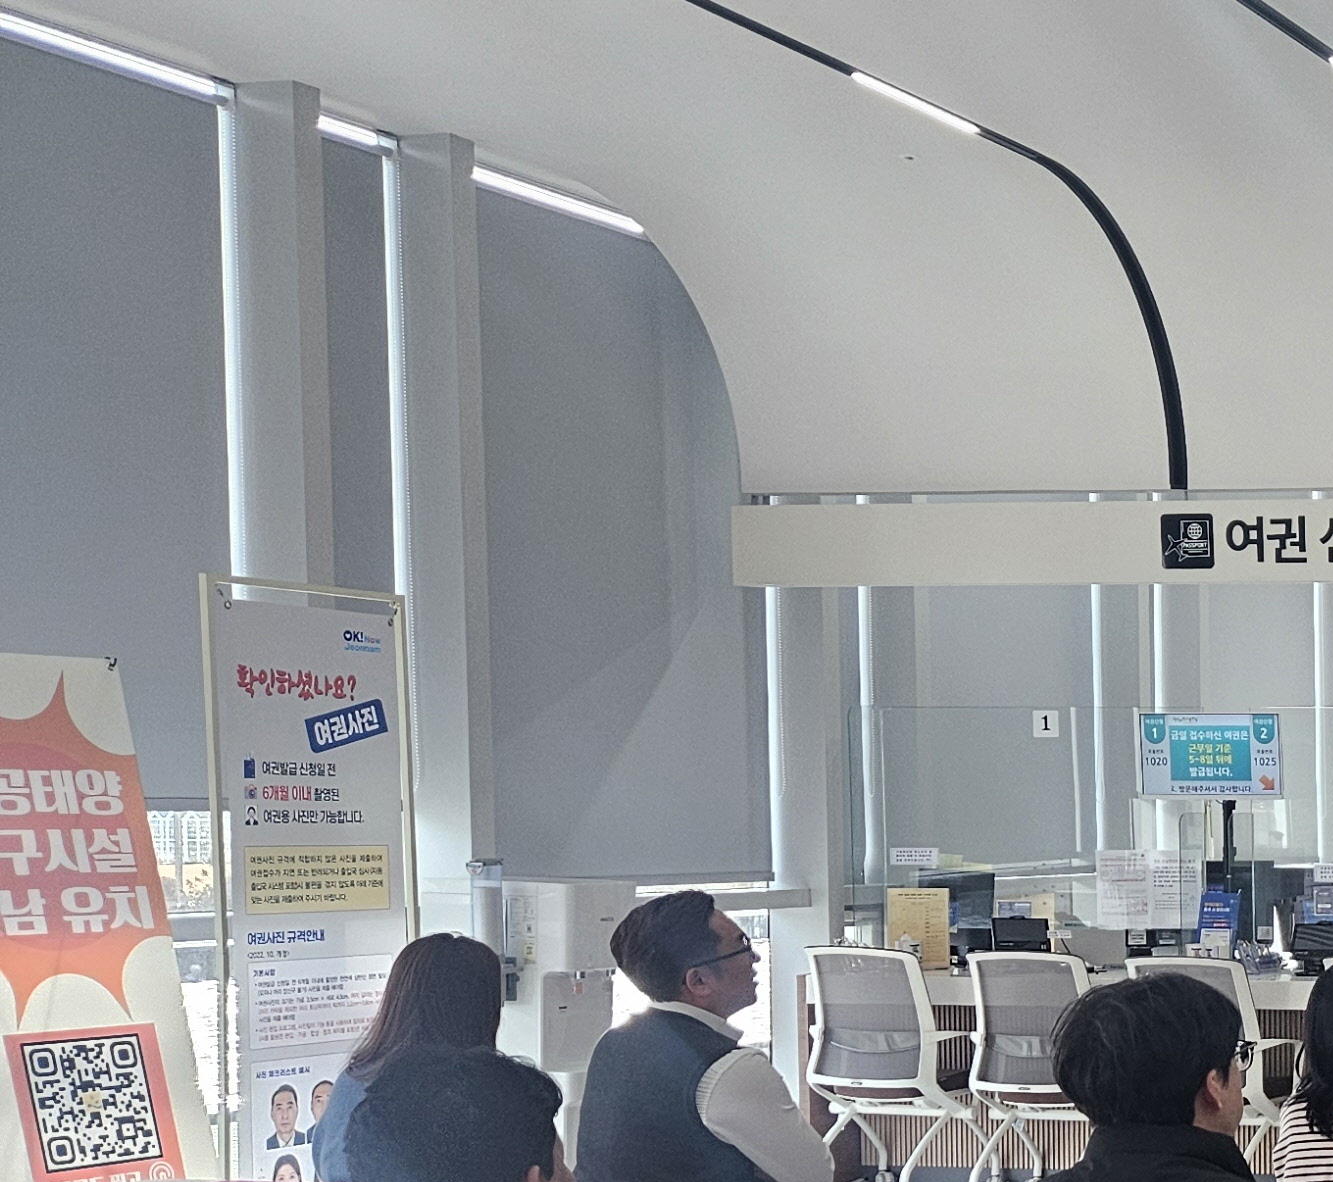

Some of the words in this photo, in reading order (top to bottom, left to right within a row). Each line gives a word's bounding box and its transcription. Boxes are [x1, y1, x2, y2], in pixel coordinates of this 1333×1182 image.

[1226, 515, 1307, 564] 여권
[343, 630, 363, 643] OK!
[237, 664, 357, 701] 확인하셨나요?
[314, 705, 380, 746] 여권사진
[1040, 715, 1051, 731] 1
[1152, 728, 1158, 739] 1
[1170, 730, 1187, 741] 금일
[1189, 730, 1222, 740] 접수하신
[1224, 730, 1249, 741] 여권은
[1260, 728, 1268, 739] 2
[1188, 744, 1213, 753] 근무일
[1215, 744, 1232, 753] 기준
[1145, 757, 1168, 766] 1020
[1188, 755, 1213, 764] 5~8일
[1215, 755, 1232, 764] 뒤에
[1254, 757, 1277, 766] 1025
[262, 761, 297, 776] 여권발급
[299, 762, 326, 776] 신청일
[327, 763, 337, 777] 전
[1189, 767, 1233, 777] 발급됩니다.
[262, 785, 289, 801] 6개월
[292, 786, 312, 801] 이내
[314, 788, 340, 801] 촬영된
[264, 810, 290, 823] 여권용
[292, 810, 318, 824] 사진만
[320, 810, 365, 824] 가능합니다.
[0, 889, 49, 936] 남
[60, 886, 155, 933] 유치
[247, 931, 285, 946] 여권사진
[287, 929, 325, 943] 규격안내
